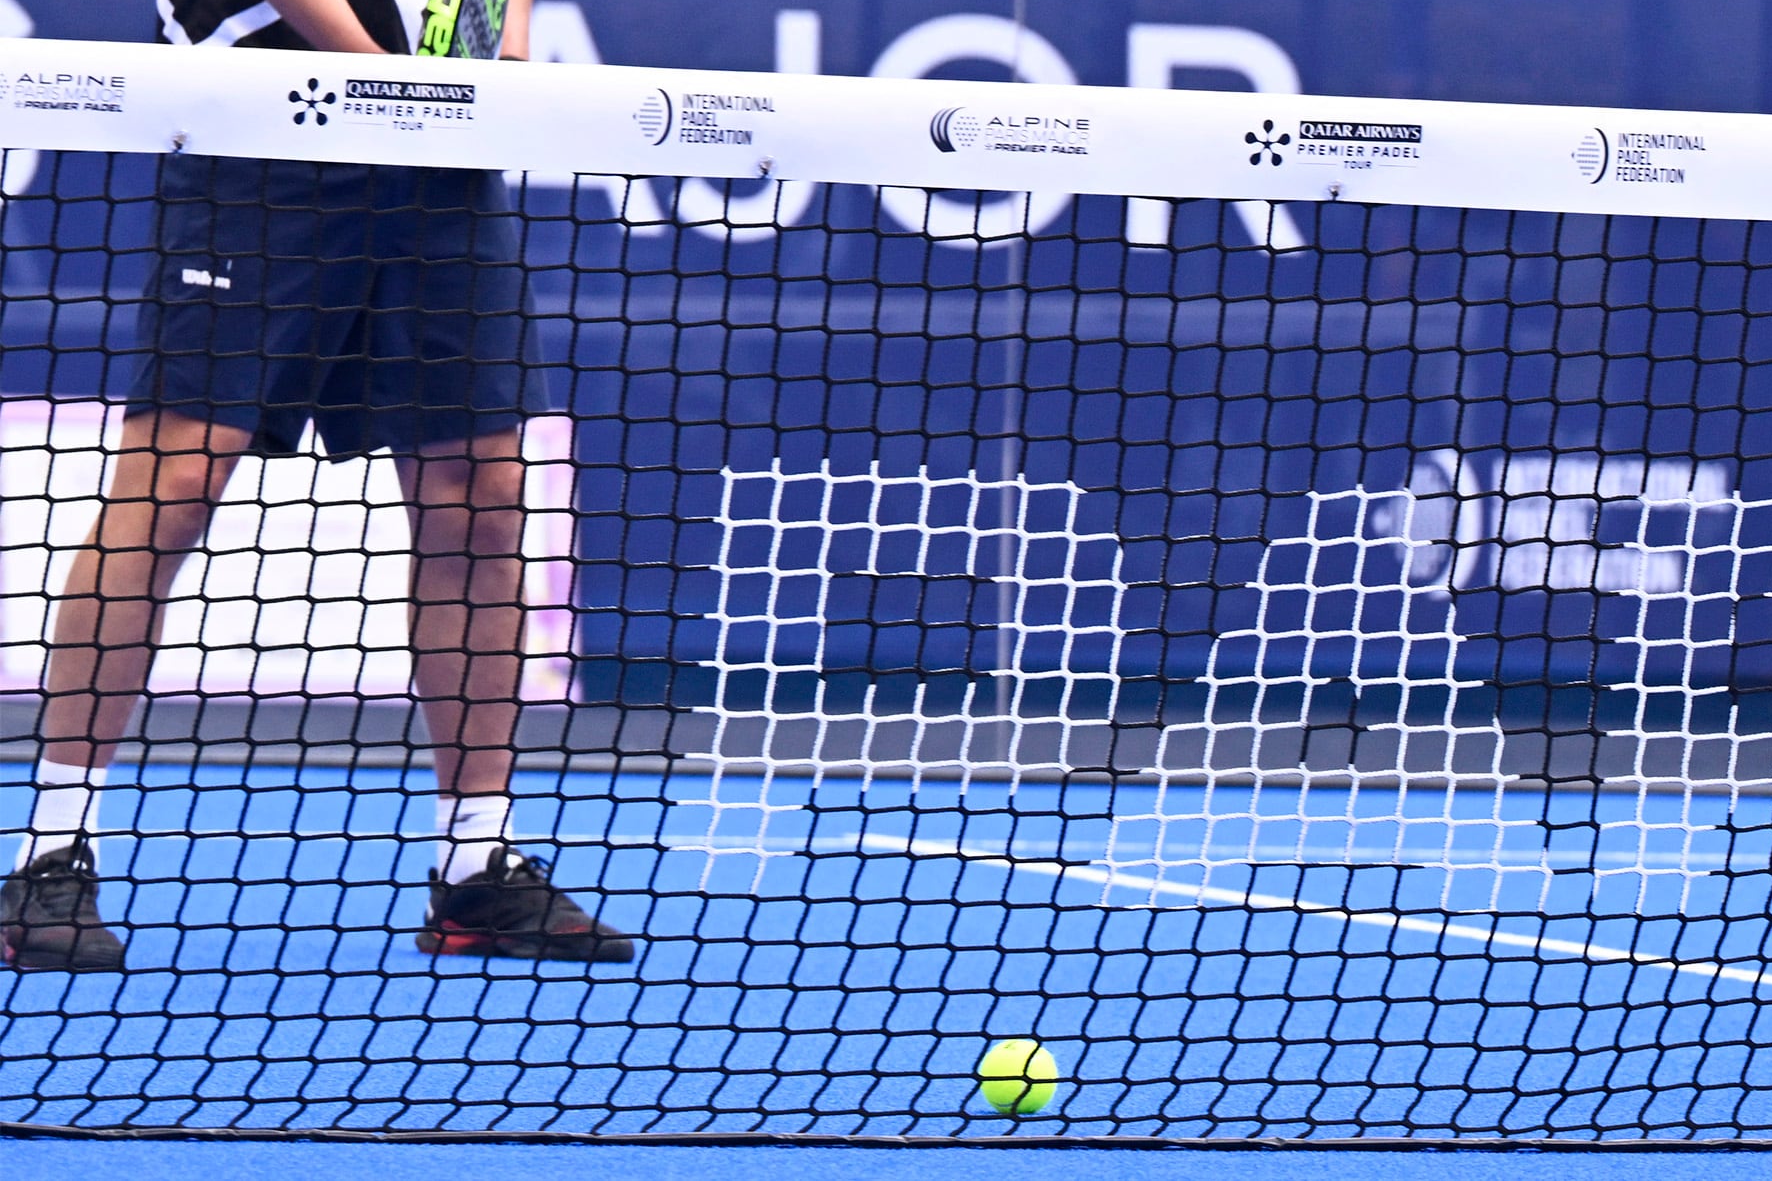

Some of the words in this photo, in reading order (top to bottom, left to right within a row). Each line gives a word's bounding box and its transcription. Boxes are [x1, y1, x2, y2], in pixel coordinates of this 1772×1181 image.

[16, 73, 126, 88] ALPINE
[14, 84, 63, 100] PARIS
[63, 87, 125, 102] MAJOR
[347, 82, 401, 97] QATAR
[404, 83, 474, 101] AIRWAYS
[25, 100, 79, 111] PREMIER
[83, 102, 123, 113] PADEL
[343, 103, 415, 117] PREMIER
[423, 106, 474, 120] PADEL
[682, 94, 776, 112] INTERNATIONAL
[392, 121, 424, 131] TOUR
[681, 111, 719, 127] PADEL
[987, 117, 1090, 130] ALPINE
[527, 1, 1306, 259] AJOR
[679, 128, 753, 145] FEDERATION
[984, 128, 1028, 142] PARIS
[1033, 130, 1090, 145] MAJOR
[1301, 123, 1353, 138] QATAR
[1355, 125, 1421, 141] AIRWAYS
[994, 143, 1047, 153] PREMIER
[1051, 145, 1088, 155] PADEL
[1618, 133, 1706, 151] INTERNATIONAL
[1297, 144, 1365, 157] PREMIER
[1371, 147, 1421, 159] PADEL
[1617, 150, 1652, 166] PADEL
[1343, 160, 1372, 170] TOUR
[1616, 166, 1685, 183] FEDERATION
